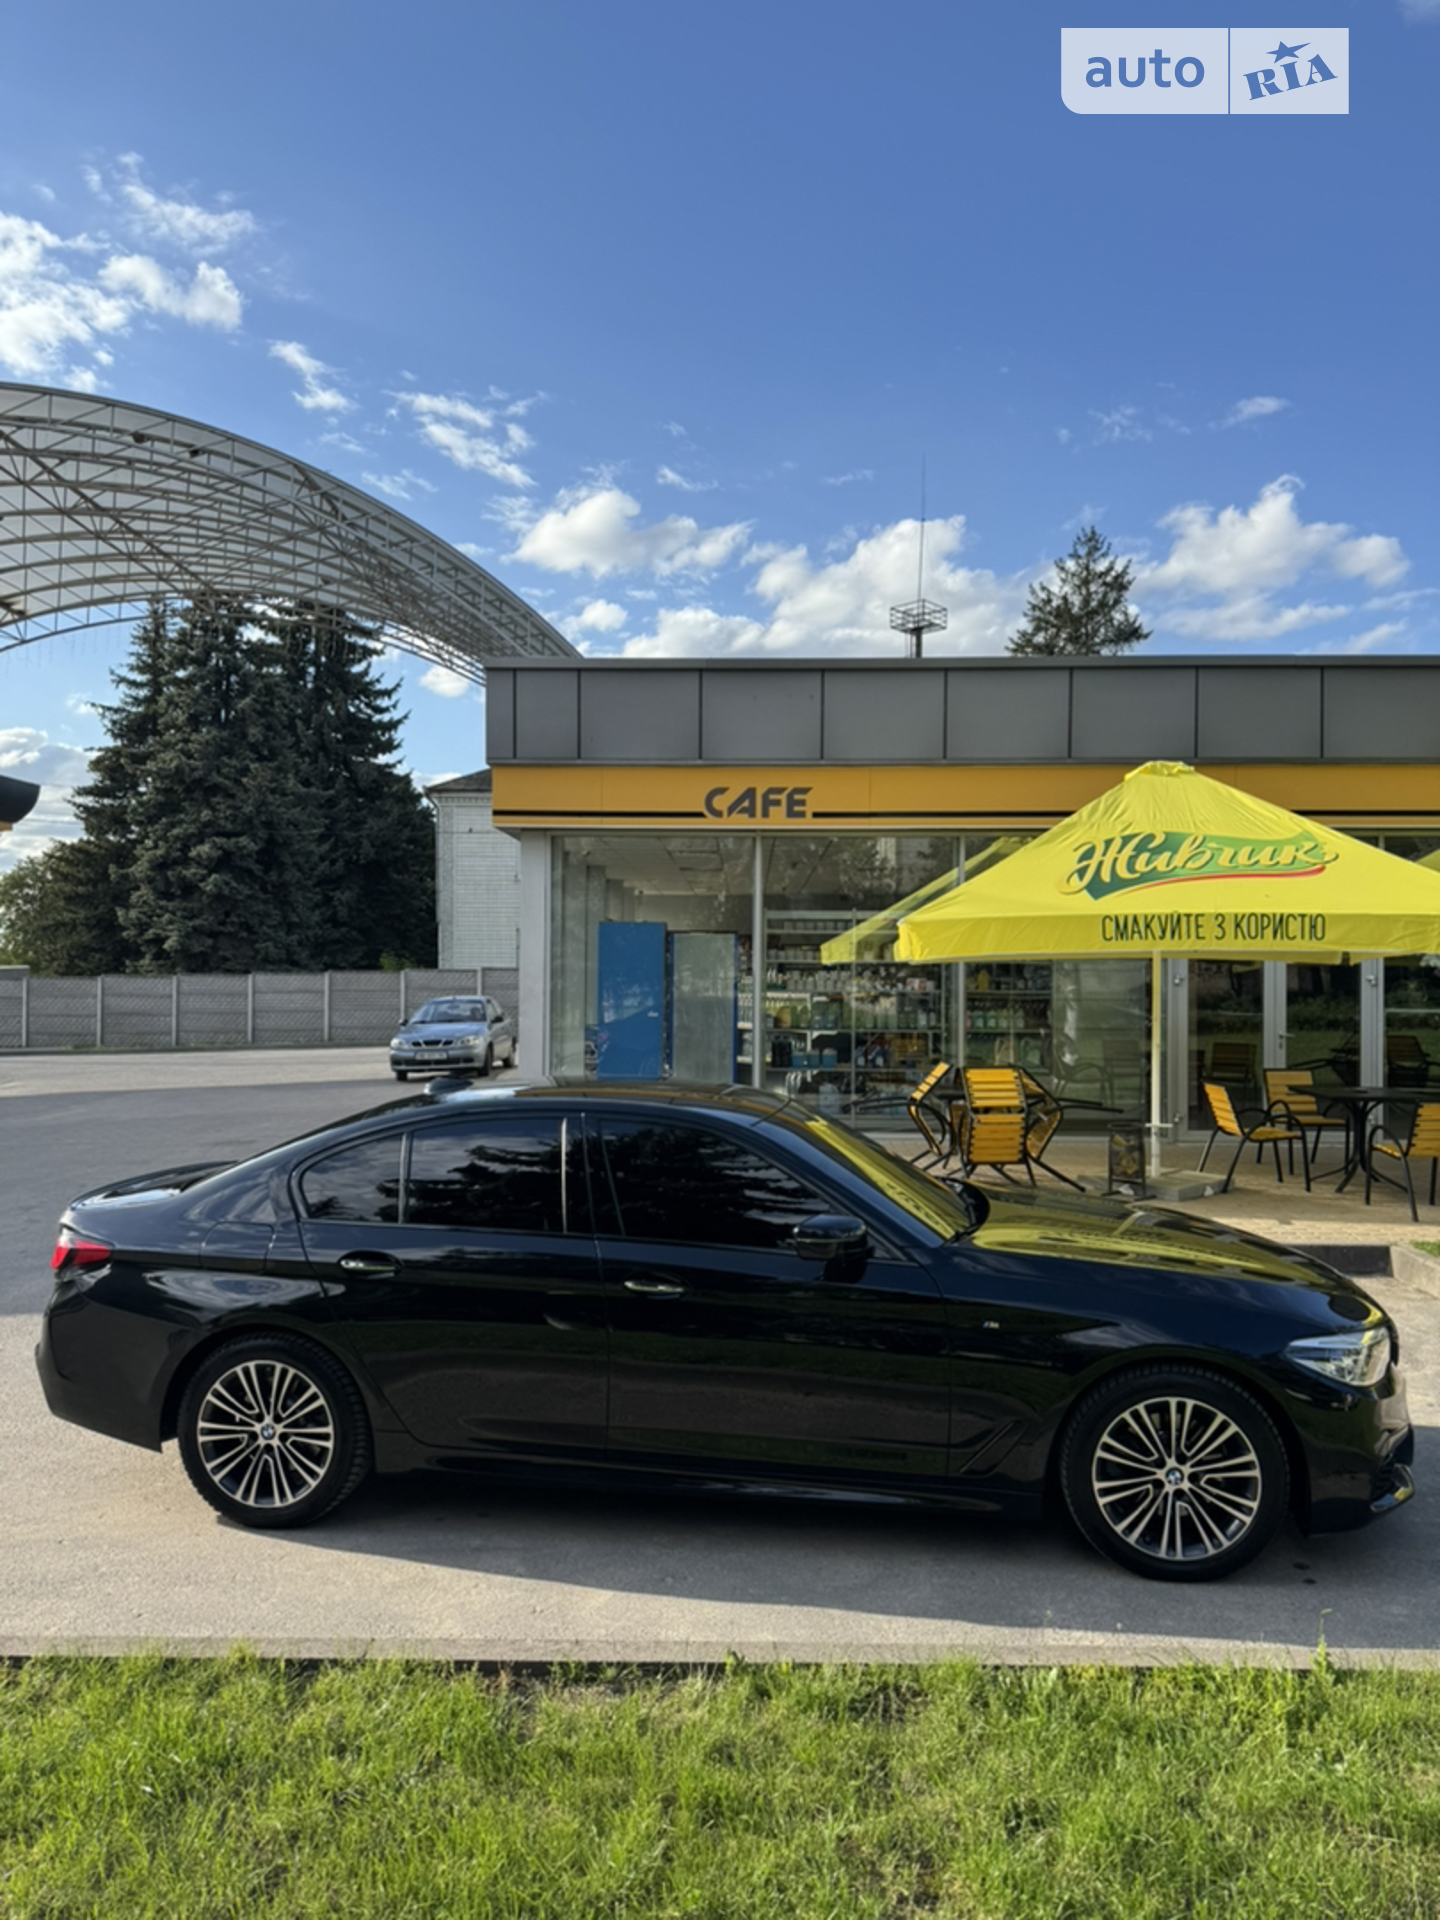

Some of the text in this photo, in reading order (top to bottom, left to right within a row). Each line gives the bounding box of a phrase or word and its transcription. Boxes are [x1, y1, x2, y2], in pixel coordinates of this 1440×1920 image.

[705, 786, 813, 818] CAFE
[1057, 831, 1339, 895] Живчик
[1101, 911, 1326, 942] СМАКУЙТЕ З КОРИСТЮ
